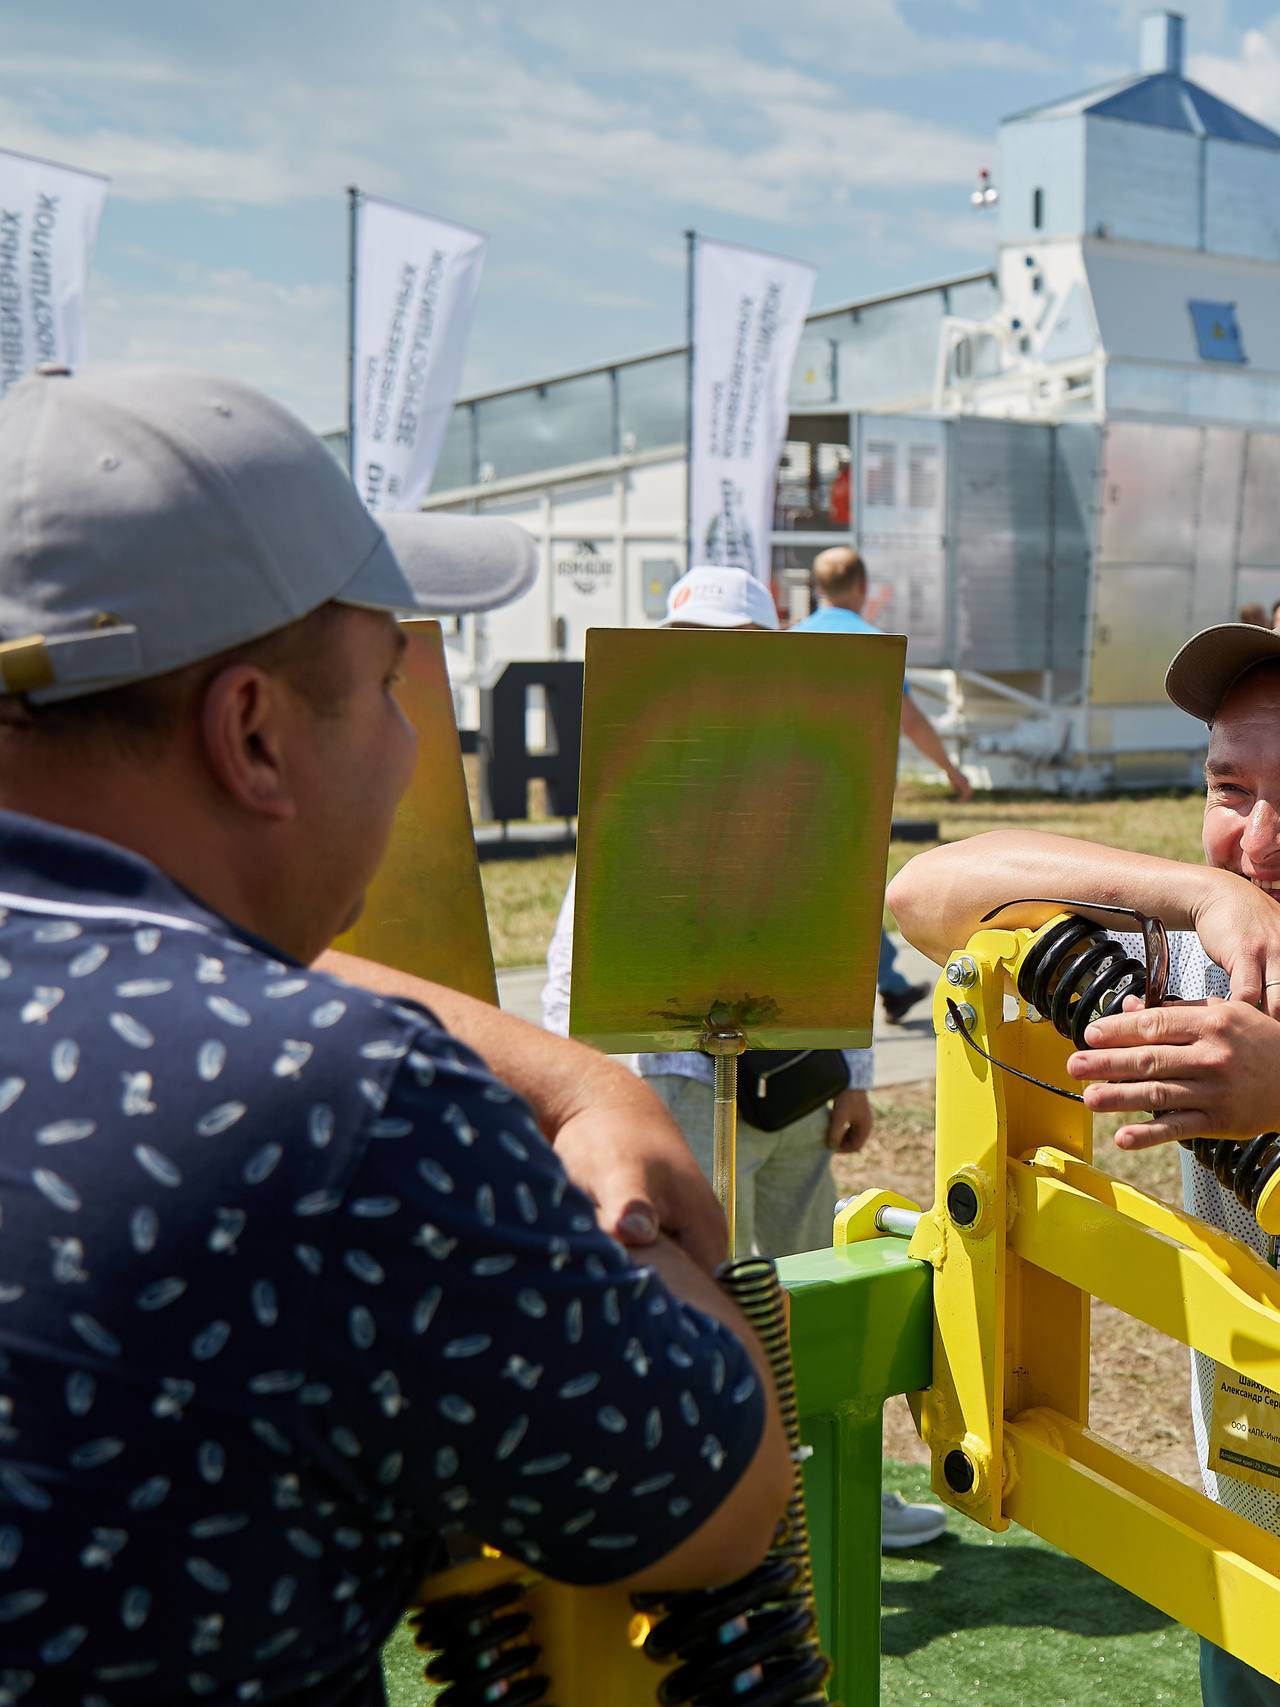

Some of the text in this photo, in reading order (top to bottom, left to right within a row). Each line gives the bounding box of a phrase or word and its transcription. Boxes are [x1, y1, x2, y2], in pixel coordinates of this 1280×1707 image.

[32, 192, 61, 363] НОСУШИЛОК
[1220, 1382, 1263, 1404] Александр
[1231, 1420, 1247, 1432] ООО
